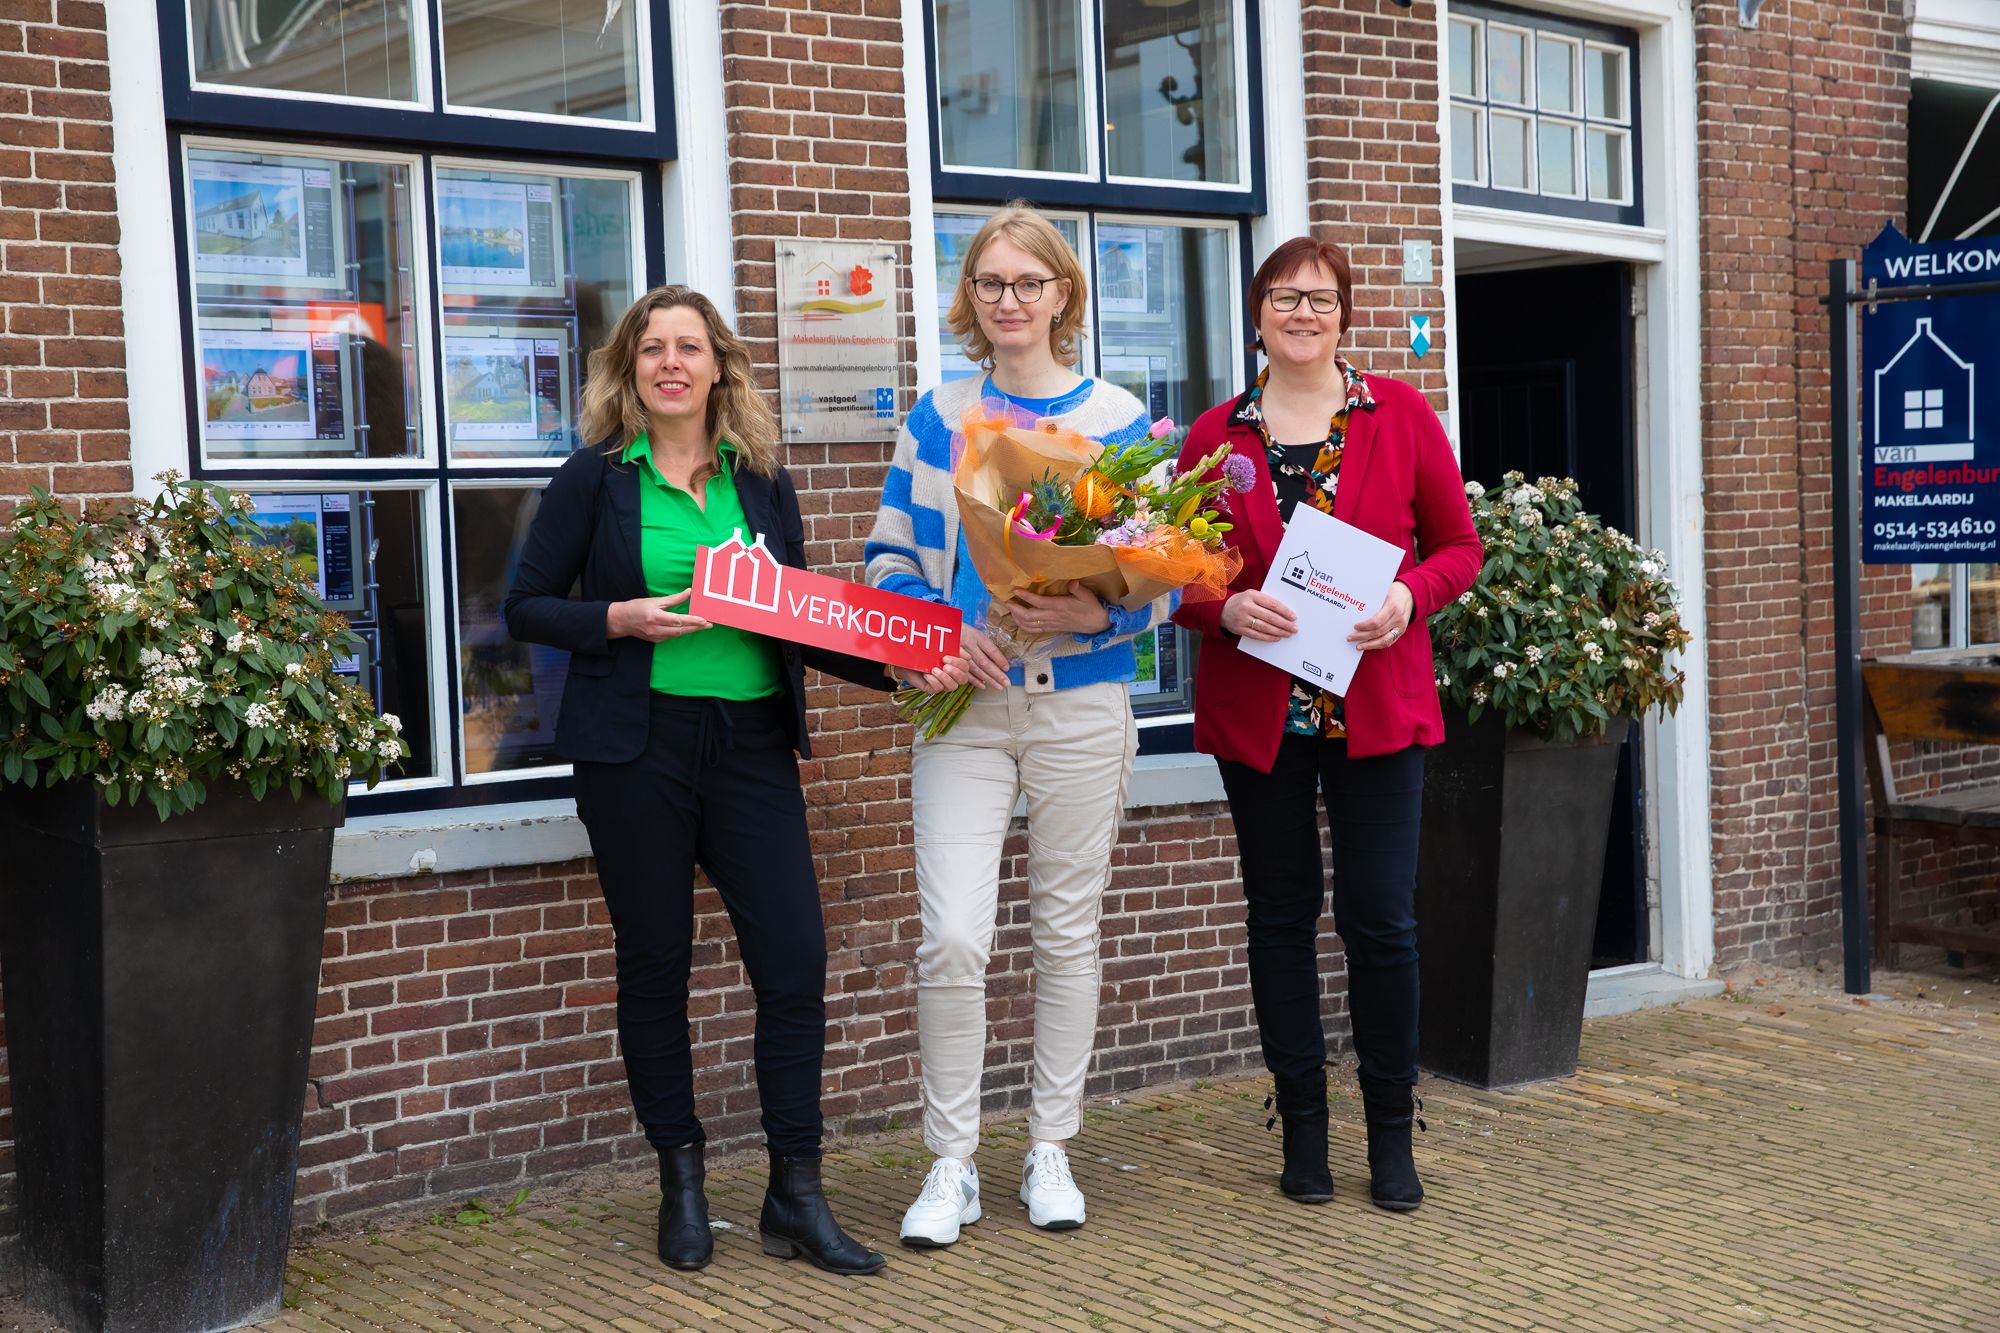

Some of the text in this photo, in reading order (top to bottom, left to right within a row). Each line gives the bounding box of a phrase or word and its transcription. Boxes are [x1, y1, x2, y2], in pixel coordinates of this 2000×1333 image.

[1413, 245, 1423, 276] 5
[1884, 249, 2000, 278] WELKOM
[793, 335, 897, 346] Makelaardij Van Engelenburg
[793, 363, 898, 373] www.makelaardijvanengelenburg.nl
[819, 395, 856, 404] vastgoed
[1877, 446, 1917, 462] van
[1874, 493, 1974, 507] MAKELAARDIJ
[1873, 517, 1996, 539] 0514-534610
[1873, 540, 1996, 552] makelaardijvanengelenburg.nl
[1315, 570, 1333, 583] van
[1307, 588, 1346, 610] MAKELAARDIJ
[1310, 577, 1366, 611] Engelenburg
[787, 590, 952, 652] VERKOCHT
